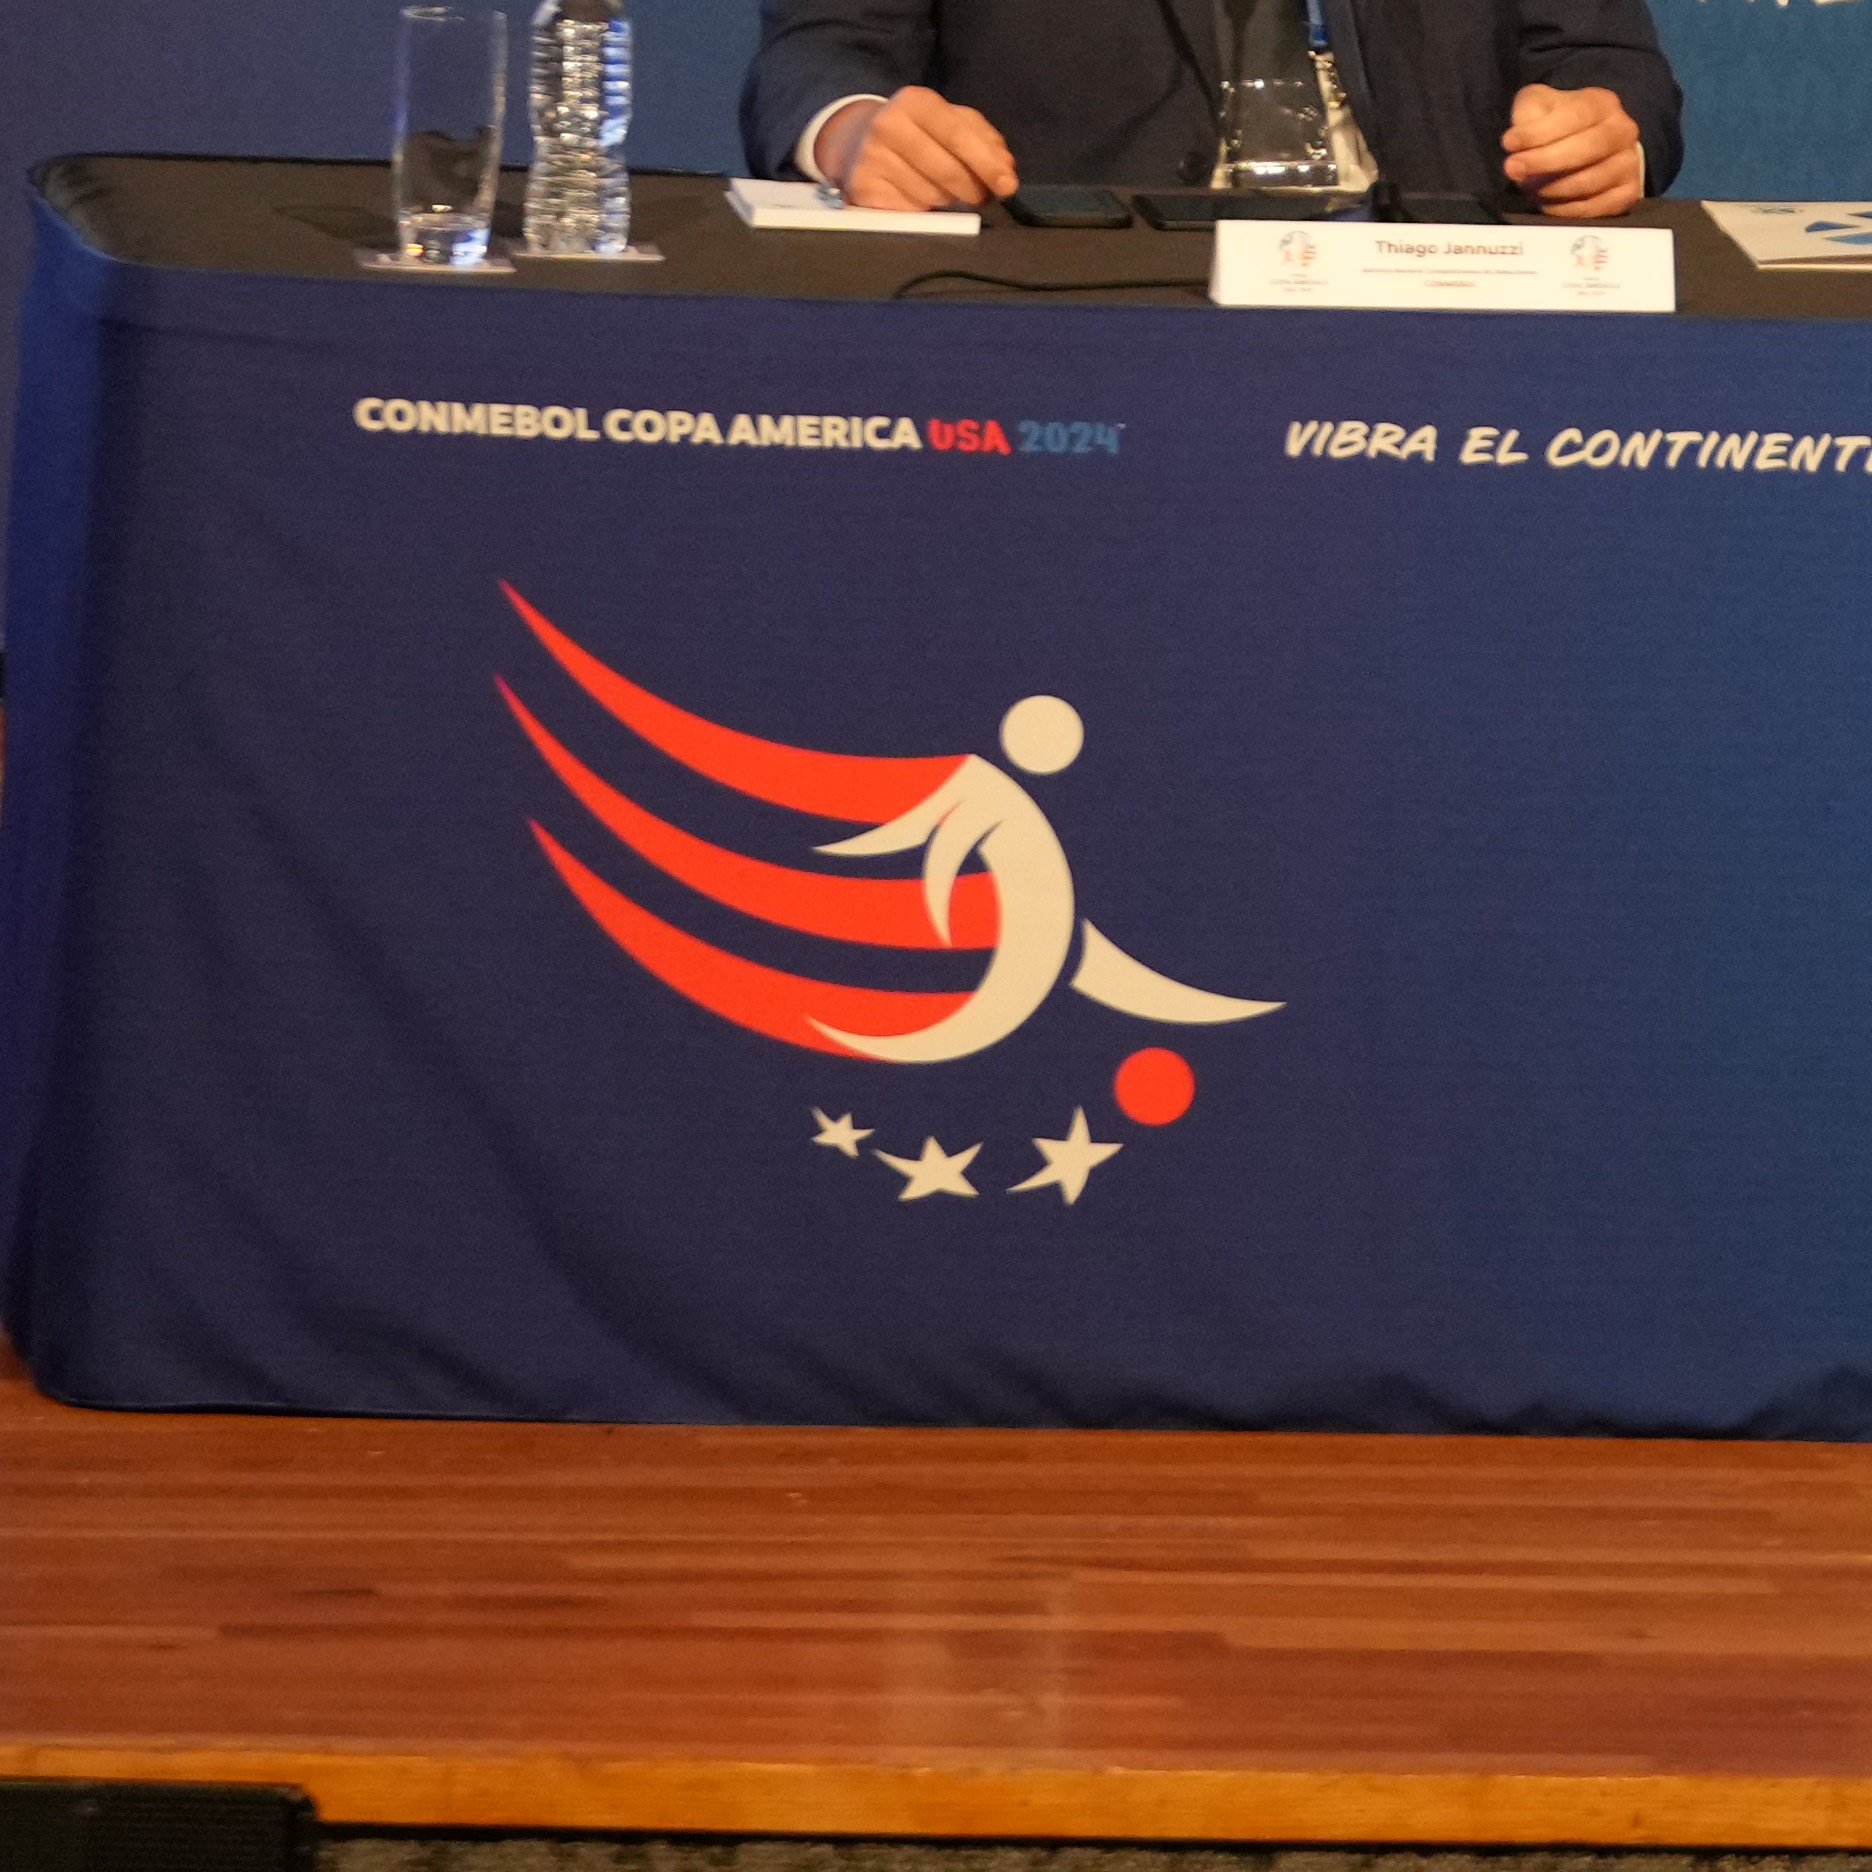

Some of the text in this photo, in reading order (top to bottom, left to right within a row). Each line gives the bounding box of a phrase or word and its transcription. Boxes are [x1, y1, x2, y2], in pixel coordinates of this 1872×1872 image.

[1375, 239, 1525, 258] Thiago Jannuzzi
[354, 396, 1120, 456] CONMEBOL COPA AMERICA USA 2024
[1285, 420, 1437, 462] VIBRA
[1459, 426, 1528, 466] EL
